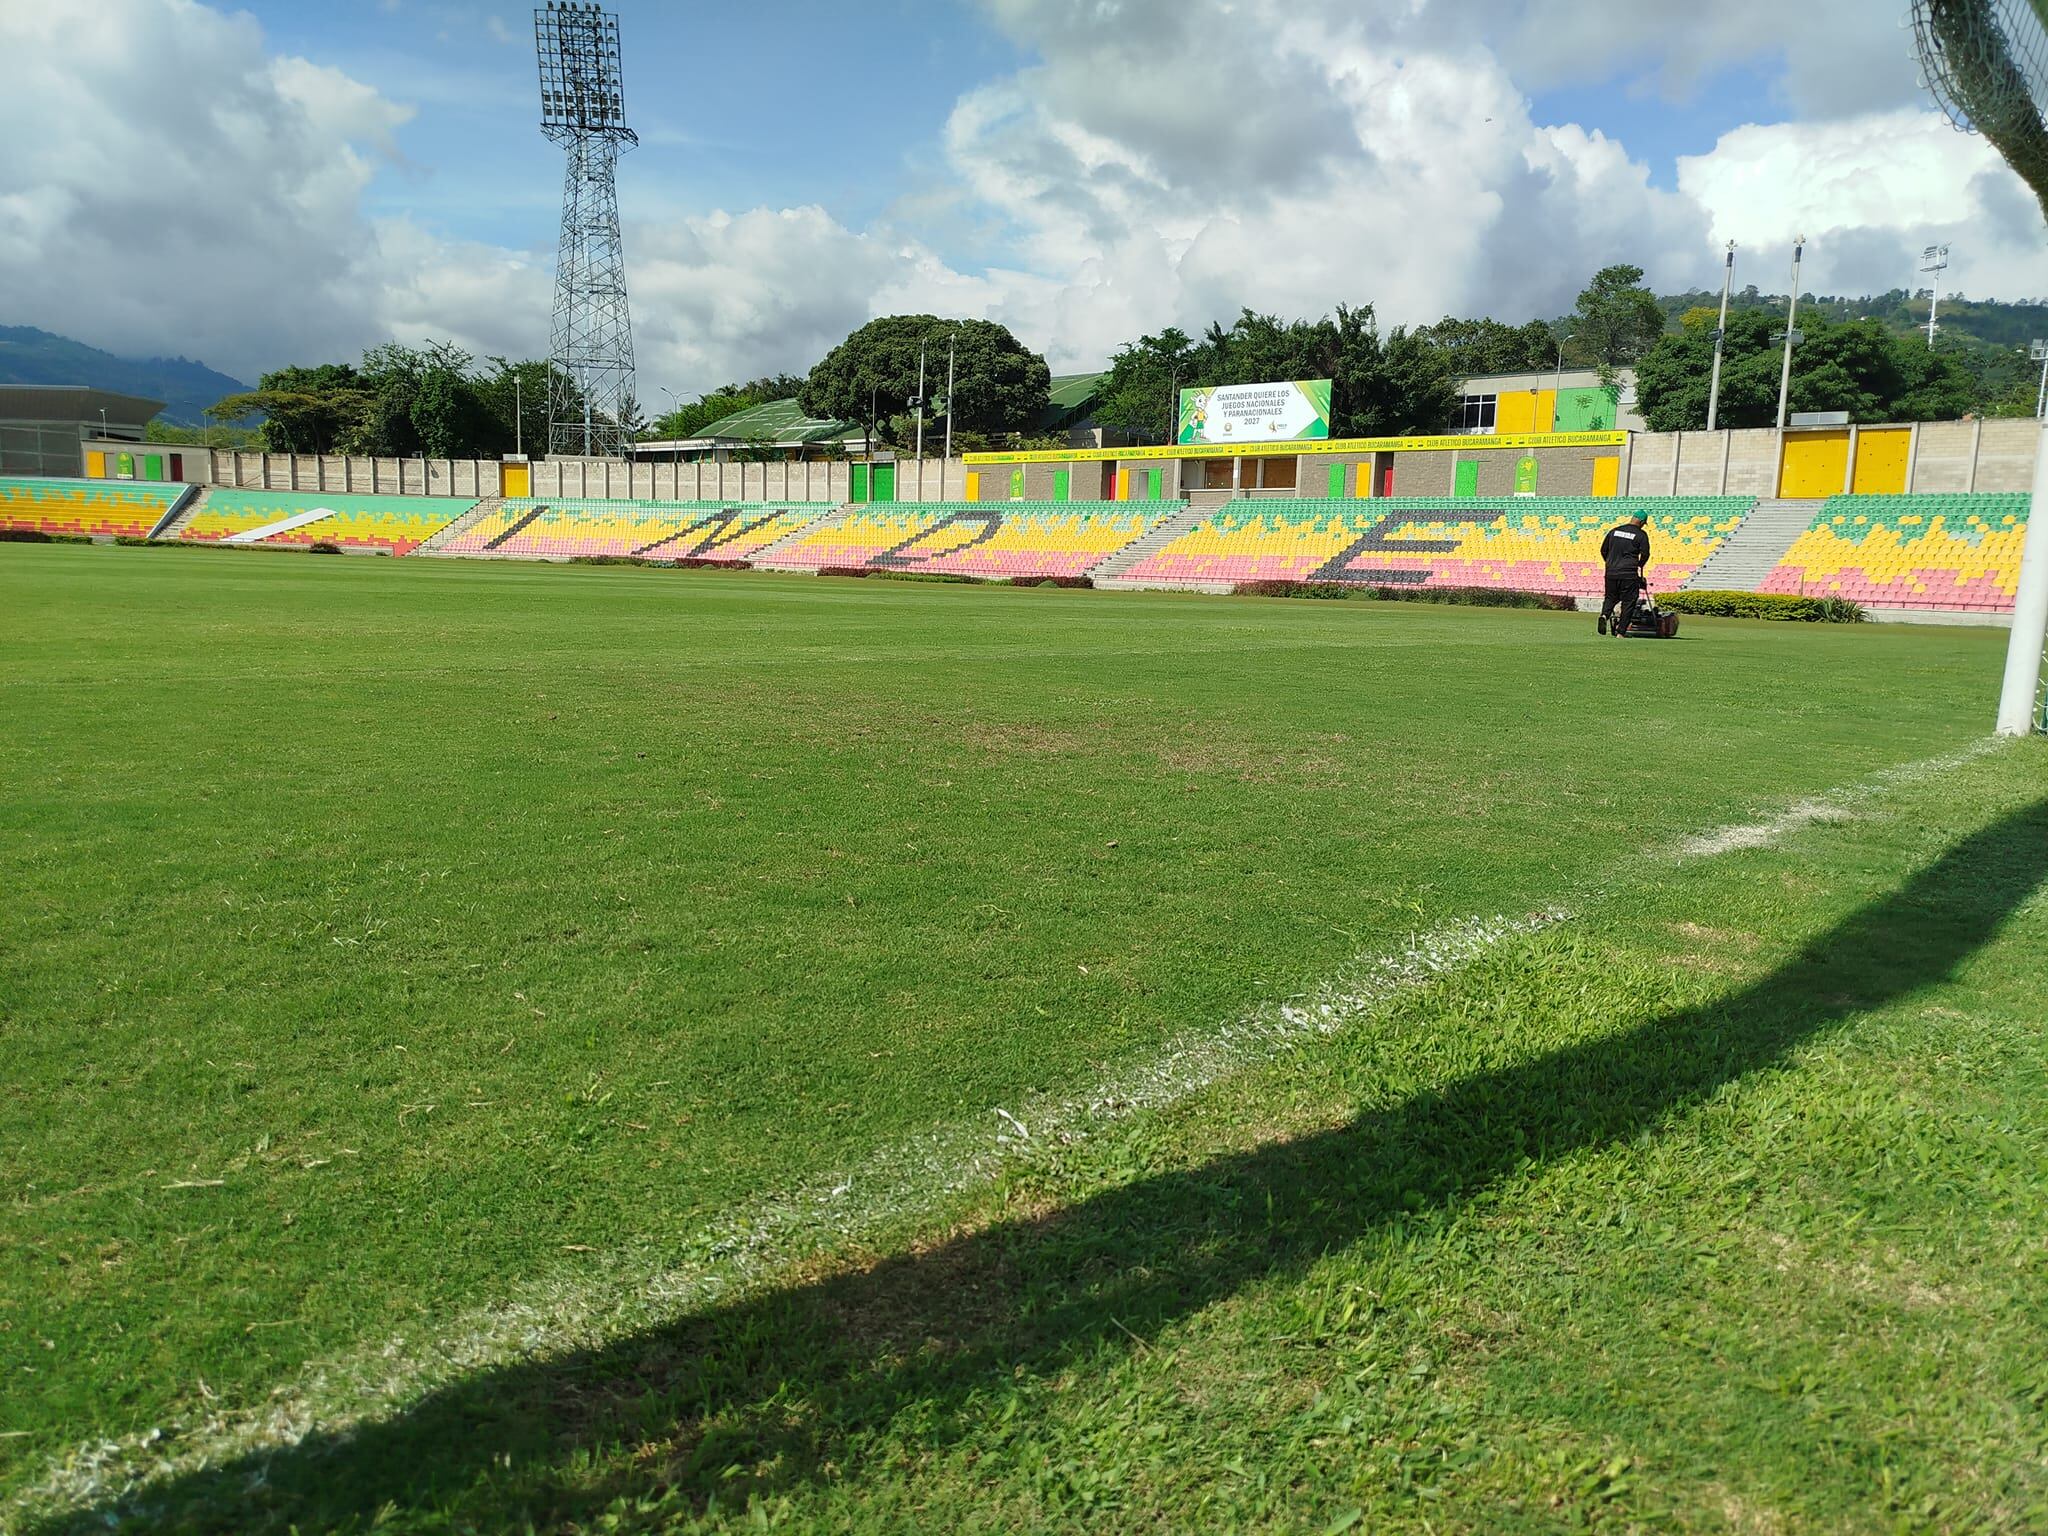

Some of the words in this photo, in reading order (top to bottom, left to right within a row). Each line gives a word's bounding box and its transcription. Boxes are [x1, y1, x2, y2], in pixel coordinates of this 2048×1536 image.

[1217, 392, 1252, 401] SANTANDER
[1254, 391, 1277, 400] QUIERE
[1221, 401, 1245, 409] JUEGOS
[1246, 399, 1285, 408] NACIONALES
[1228, 408, 1282, 417] PARANACIONALES
[1244, 417, 1260, 425] 2027
[1462, 437, 1501, 446] BUCARAMANGA
[1568, 434, 1611, 443] BUCARAMANGA
